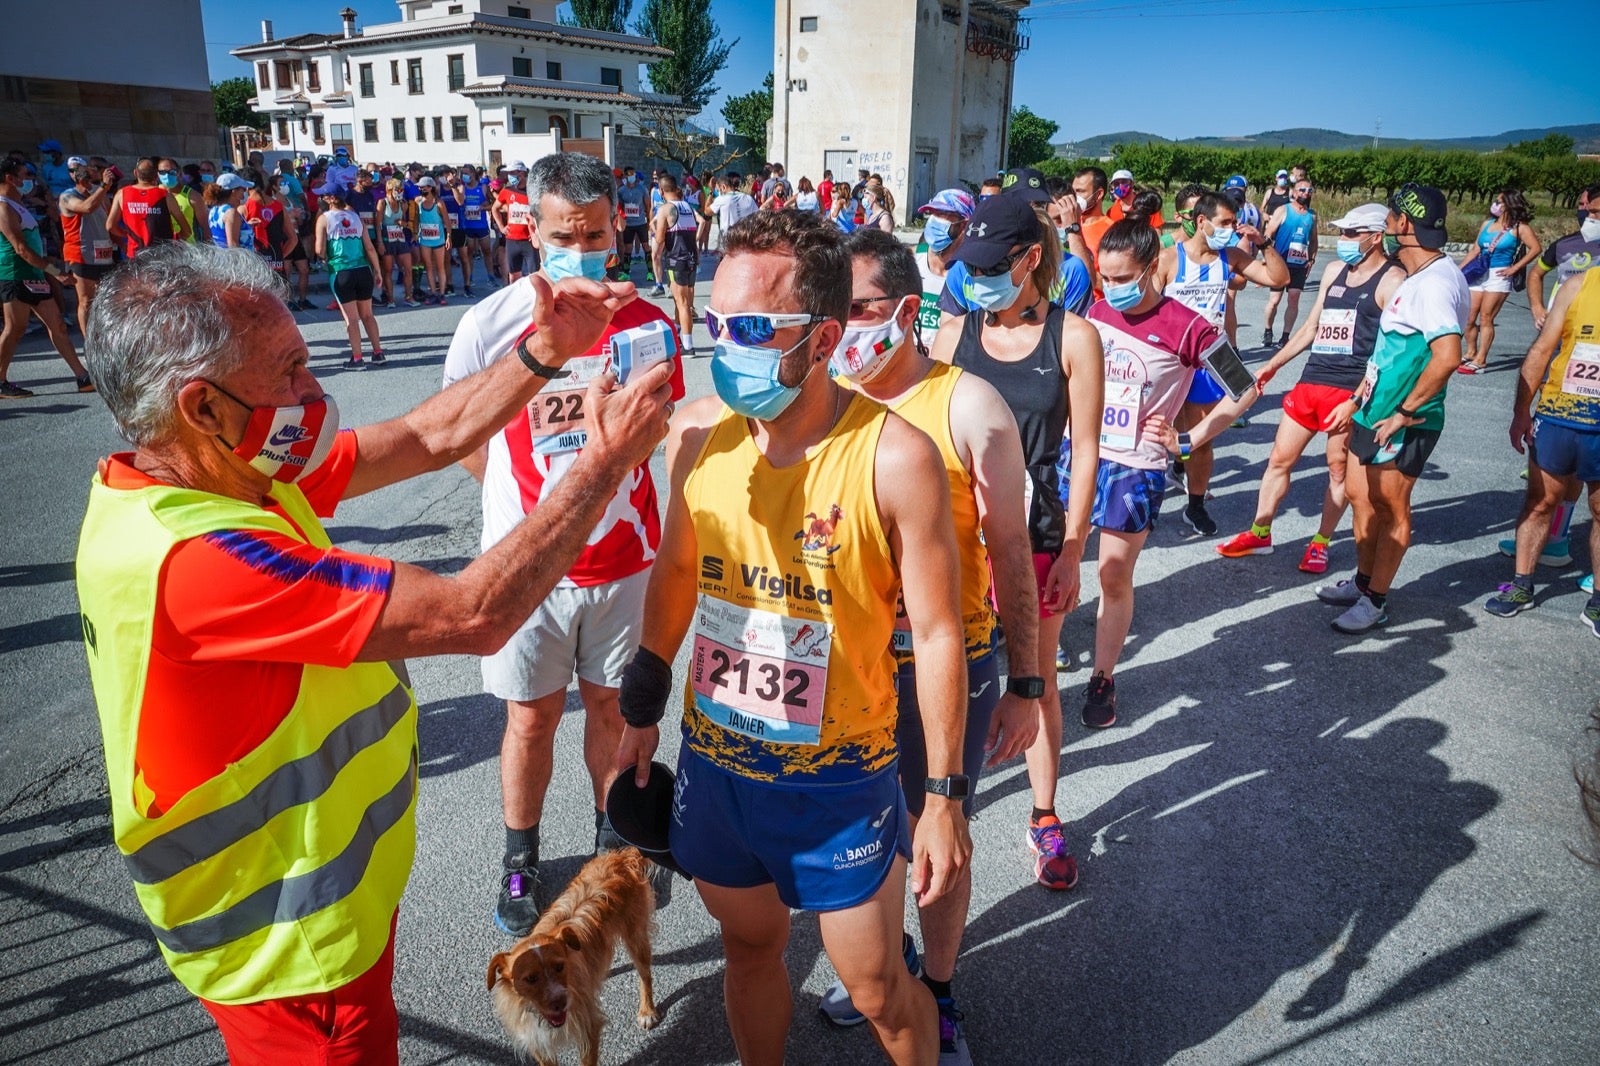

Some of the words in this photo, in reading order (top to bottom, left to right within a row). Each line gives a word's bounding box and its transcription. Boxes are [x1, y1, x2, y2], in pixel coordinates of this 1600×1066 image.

[882, 151, 893, 162] LO
[1320, 326, 1349, 340] 2058
[1573, 363, 1600, 381] 22
[545, 394, 585, 424] 22
[1103, 407, 1130, 428] 80
[278, 424, 308, 438] NIKE
[558, 434, 580, 448] JUAN
[258, 449, 310, 466] Plus500
[792, 555, 803, 565] Los
[741, 563, 833, 606] Vigilsa
[736, 592, 781, 607] Concesionario
[695, 653, 705, 684] MASTER
[709, 649, 810, 708] 2132
[727, 711, 765, 736] JAVIER
